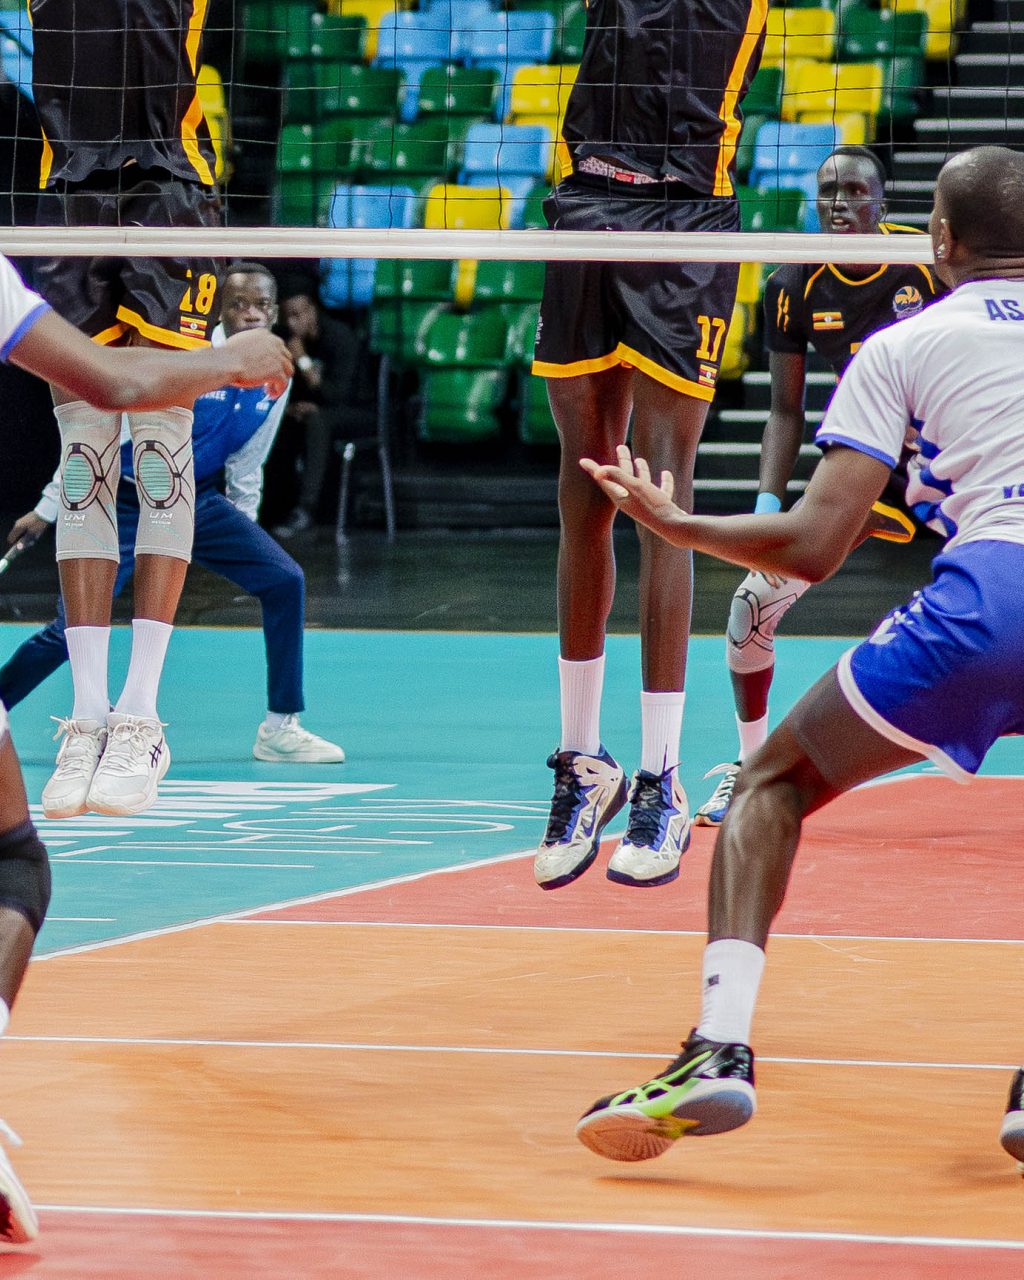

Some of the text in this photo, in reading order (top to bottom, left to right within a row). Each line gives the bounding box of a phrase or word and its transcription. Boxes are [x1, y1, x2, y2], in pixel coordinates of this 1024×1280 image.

[179, 269, 217, 315] 18
[984, 299, 1024, 321] AS
[696, 315, 726, 362] 17
